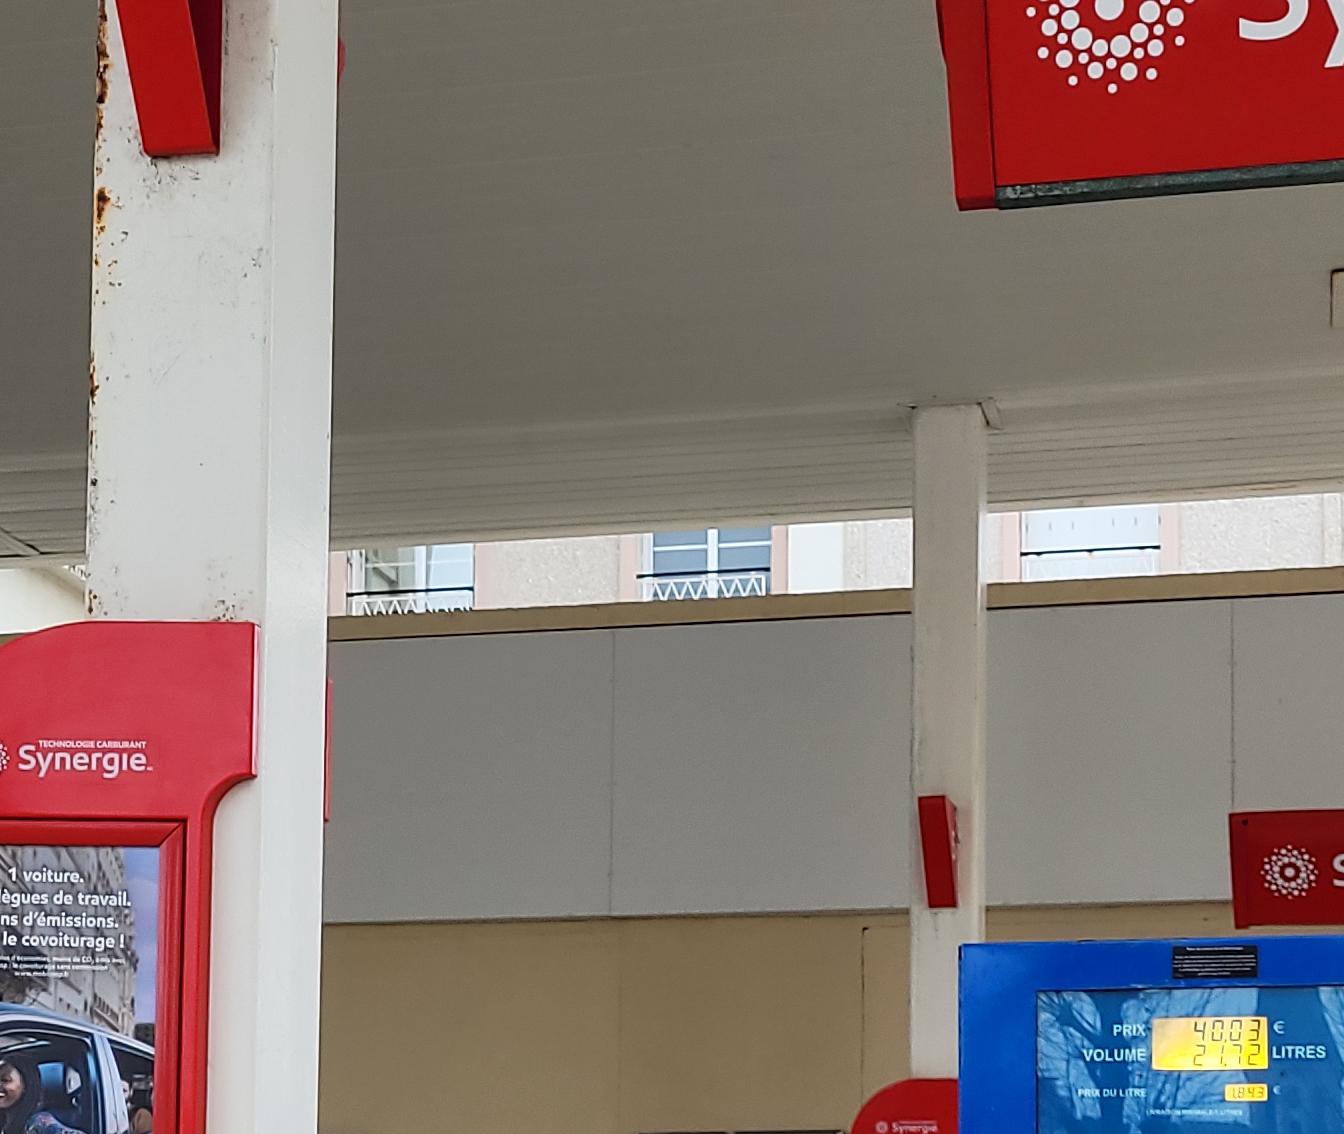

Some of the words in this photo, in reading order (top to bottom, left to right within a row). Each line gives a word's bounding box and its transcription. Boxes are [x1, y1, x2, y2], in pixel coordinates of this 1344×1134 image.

[18, 744, 148, 779] Synergie
[8, 868, 17, 881] 1
[23, 867, 84, 883] voiture.
[53, 890, 73, 905] de
[77, 890, 131, 907] travail.
[3, 931, 17, 946] le
[21, 931, 115, 951] covoiturage
[119, 933, 125, 948] !
[1113, 1024, 1146, 1036] PRIX
[1273, 1021, 1285, 1035] €
[1083, 1048, 1146, 1062] VOLUME
[1272, 1045, 1327, 1059] LITRES
[1078, 1088, 1101, 1098] PRIX
[1102, 1088, 1117, 1097] DU
[1119, 1087, 1147, 1097] LITRE
